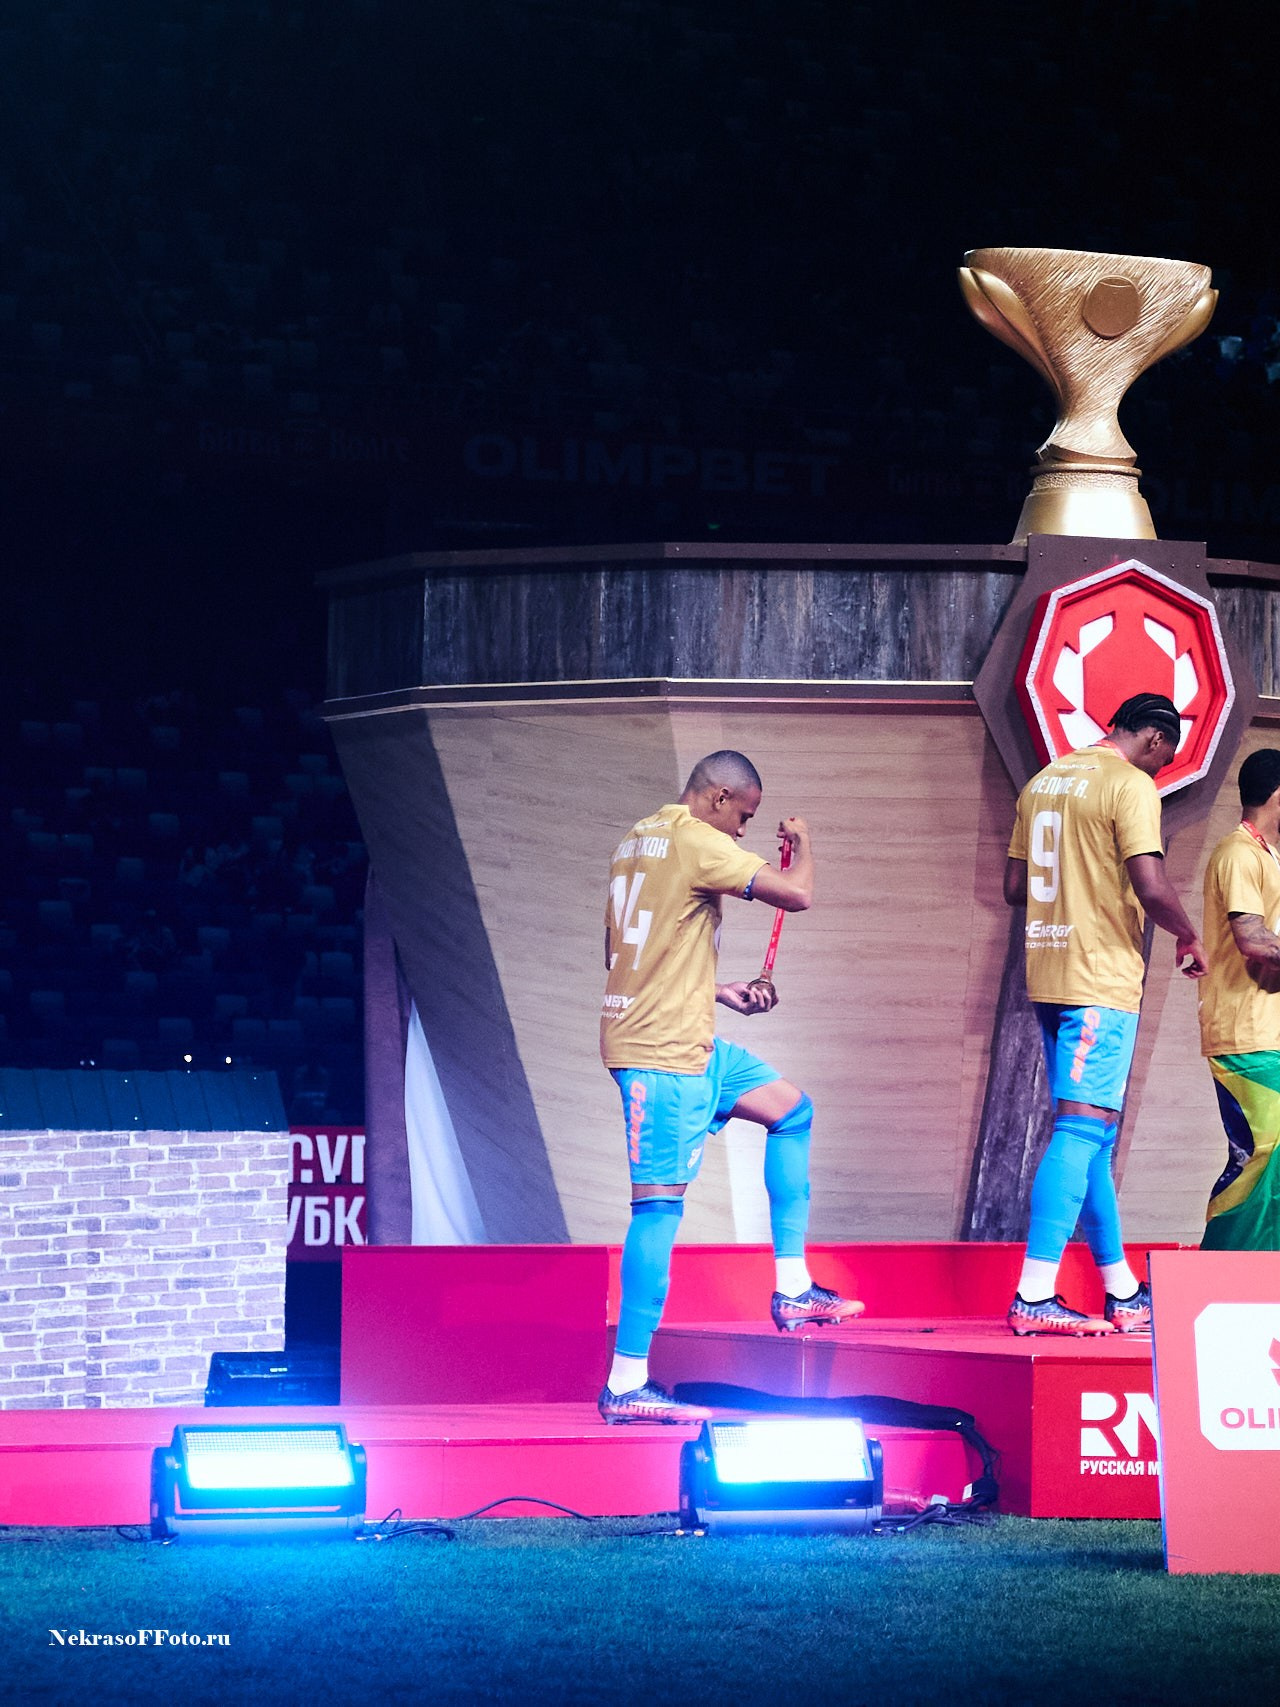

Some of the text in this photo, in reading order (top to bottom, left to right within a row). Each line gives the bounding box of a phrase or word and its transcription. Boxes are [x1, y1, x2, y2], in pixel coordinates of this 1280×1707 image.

[462, 434, 839, 497] OLIMPBET
[1030, 811, 1062, 902] 9
[609, 872, 653, 971] 14
[1080, 1460, 1145, 1476] РУССКАЯ
